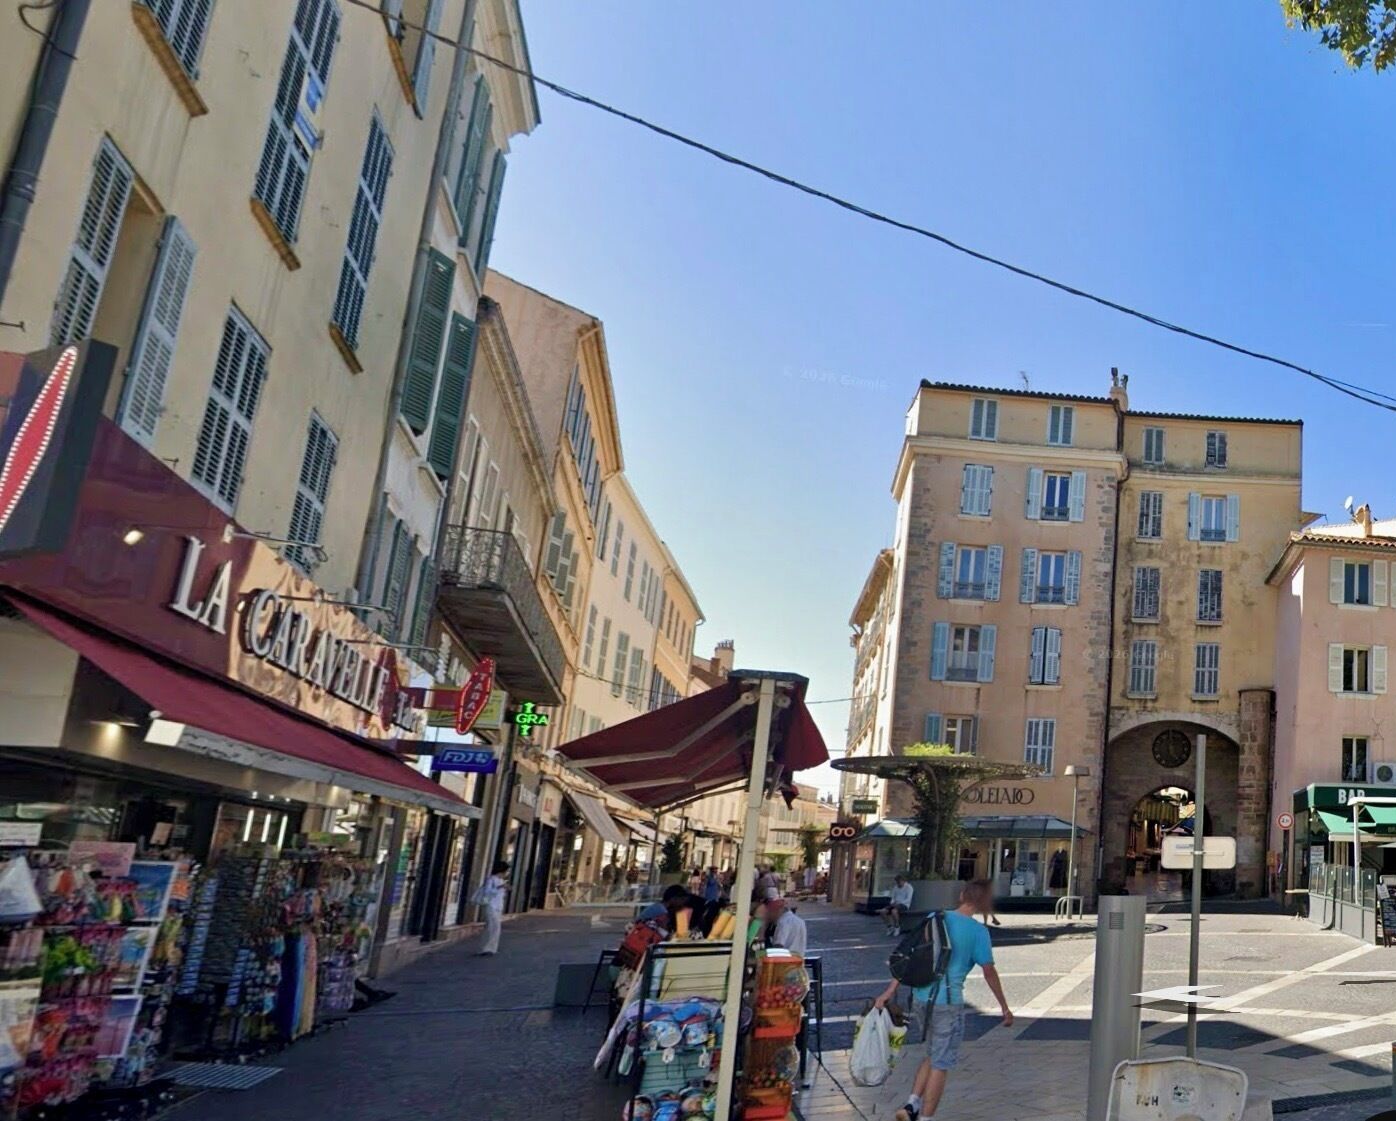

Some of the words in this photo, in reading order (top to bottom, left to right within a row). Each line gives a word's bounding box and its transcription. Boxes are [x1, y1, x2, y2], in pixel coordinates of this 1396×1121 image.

[170, 535, 232, 635] LA
[247, 589, 390, 717] CARAVELLE
[463, 672, 486, 719] TABAC
[516, 714, 549, 725] GRA
[443, 751, 475, 763] FDJ
